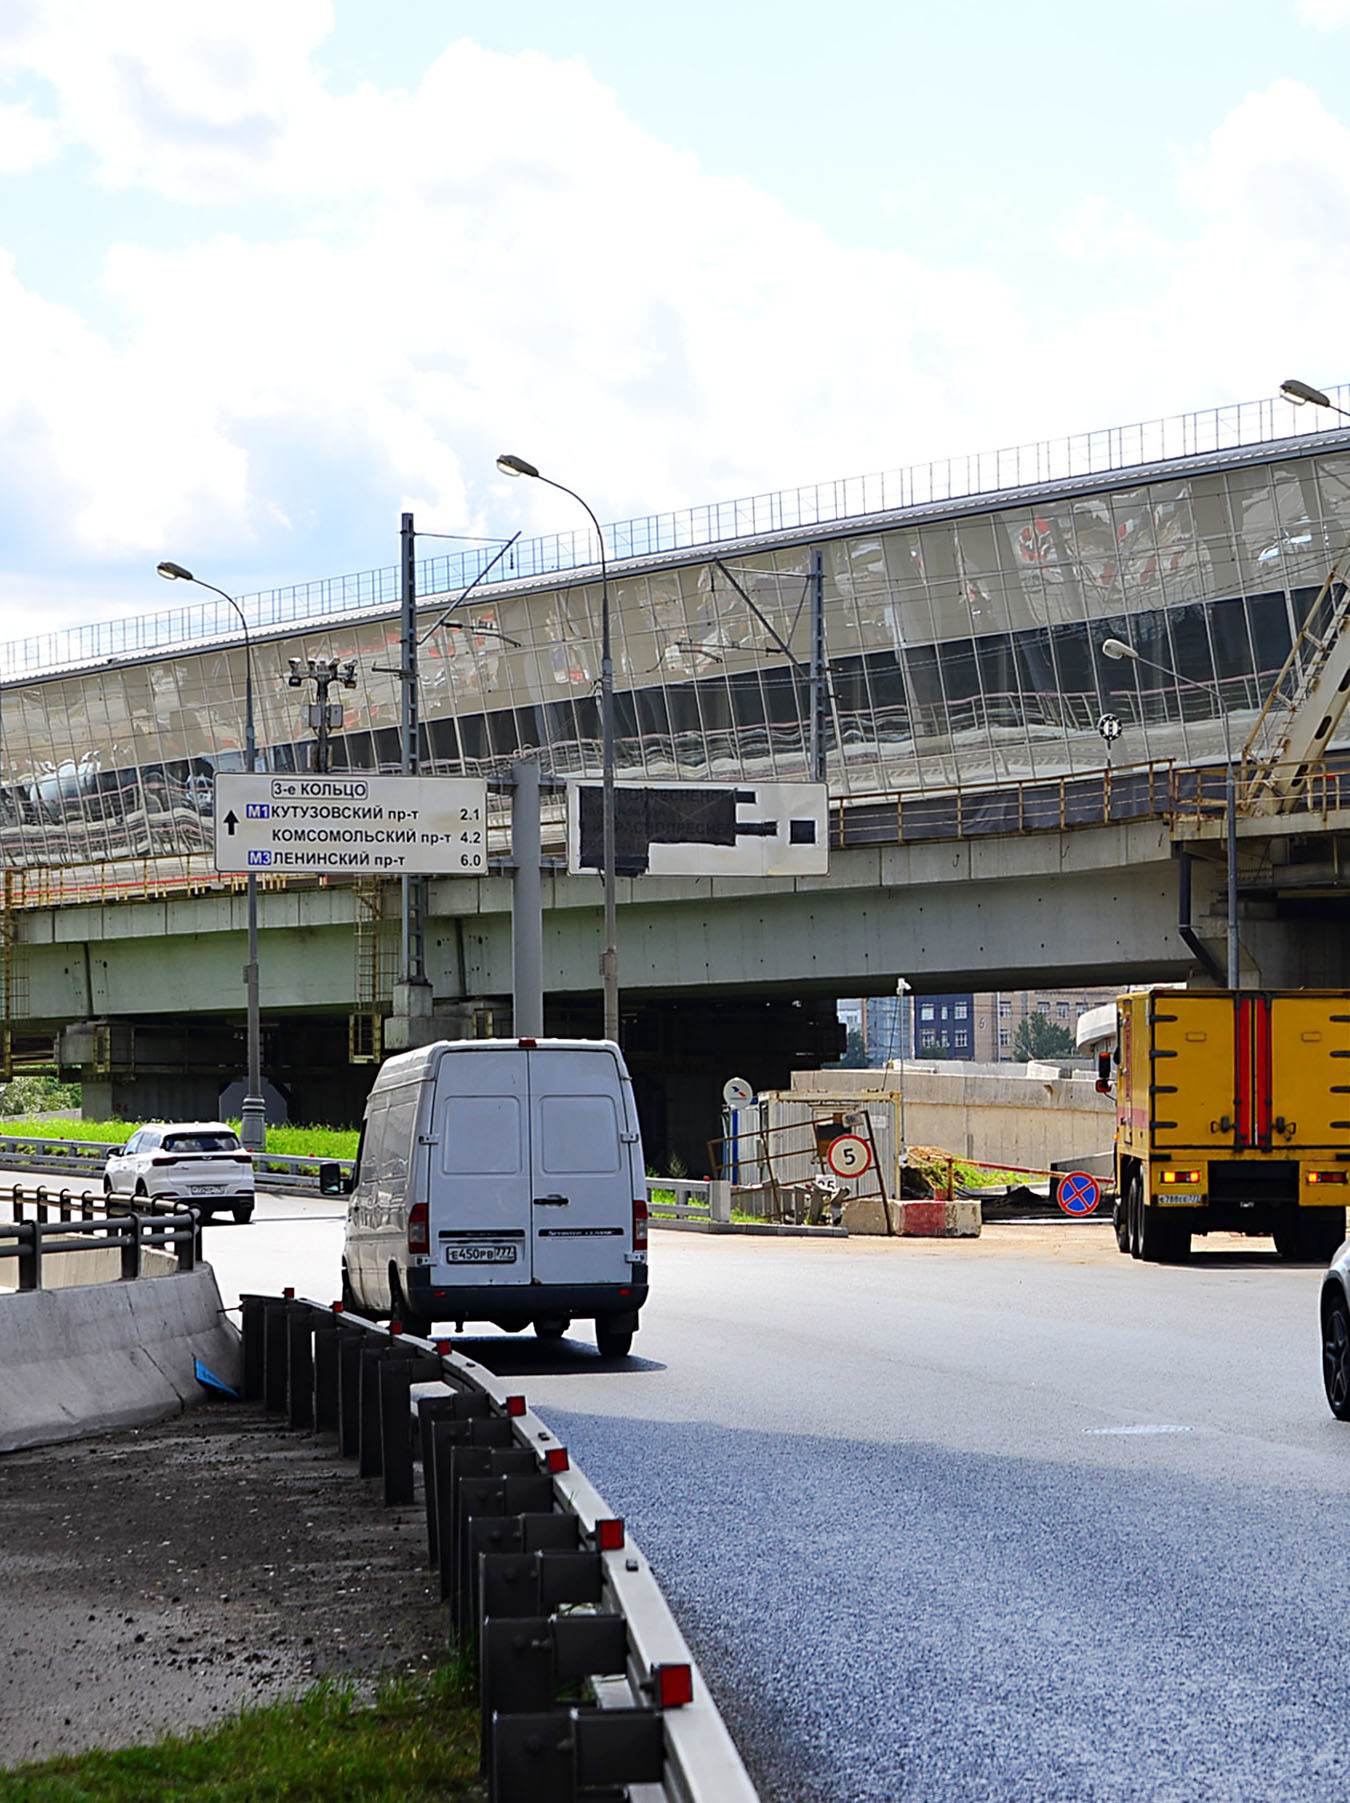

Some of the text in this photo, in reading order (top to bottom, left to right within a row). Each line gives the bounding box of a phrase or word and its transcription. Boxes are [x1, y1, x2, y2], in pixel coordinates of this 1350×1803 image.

[274, 783, 366, 798] 3-е КОЛЬЦО
[247, 804, 479, 823] М1 КУТУЗОВСКИЙ пр-т 2.1
[272, 827, 481, 846] КОМСОМОЛЬСКИЙ пр-т 4.2
[250, 850, 481, 869] М3 ЛЕНИНСКИЙ пр-т 6.0
[843, 1148, 856, 1165] 5
